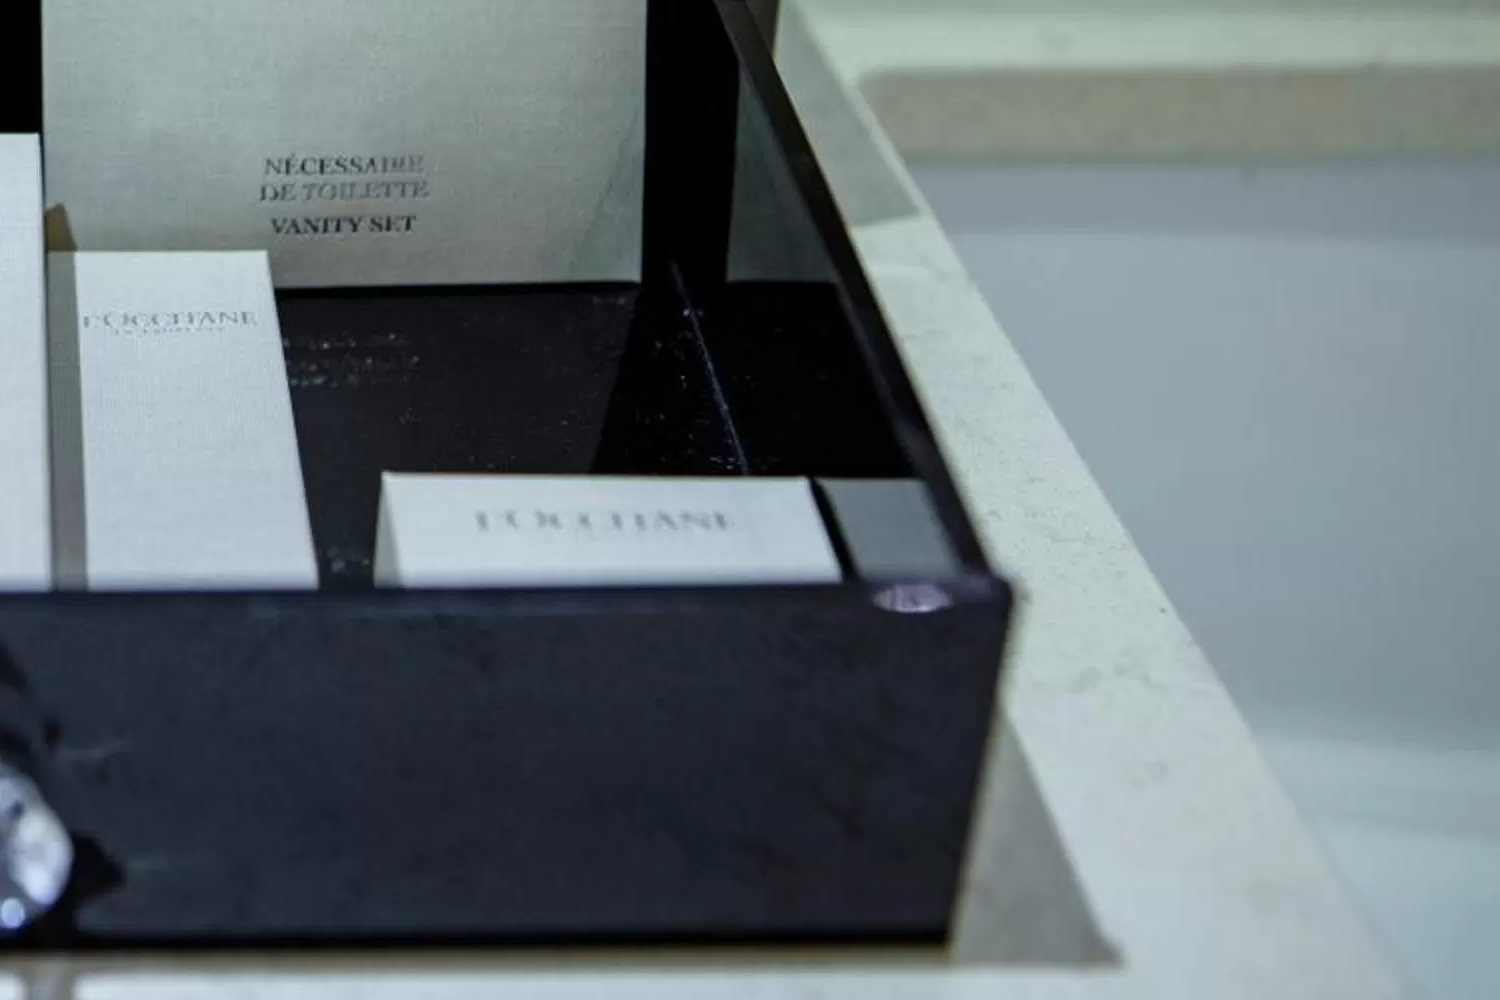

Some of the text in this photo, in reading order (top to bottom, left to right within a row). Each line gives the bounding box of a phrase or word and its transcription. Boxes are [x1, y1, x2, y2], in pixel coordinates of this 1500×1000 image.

[259, 180, 430, 201] DE TOILETTE
[269, 214, 417, 234] VANITY SET
